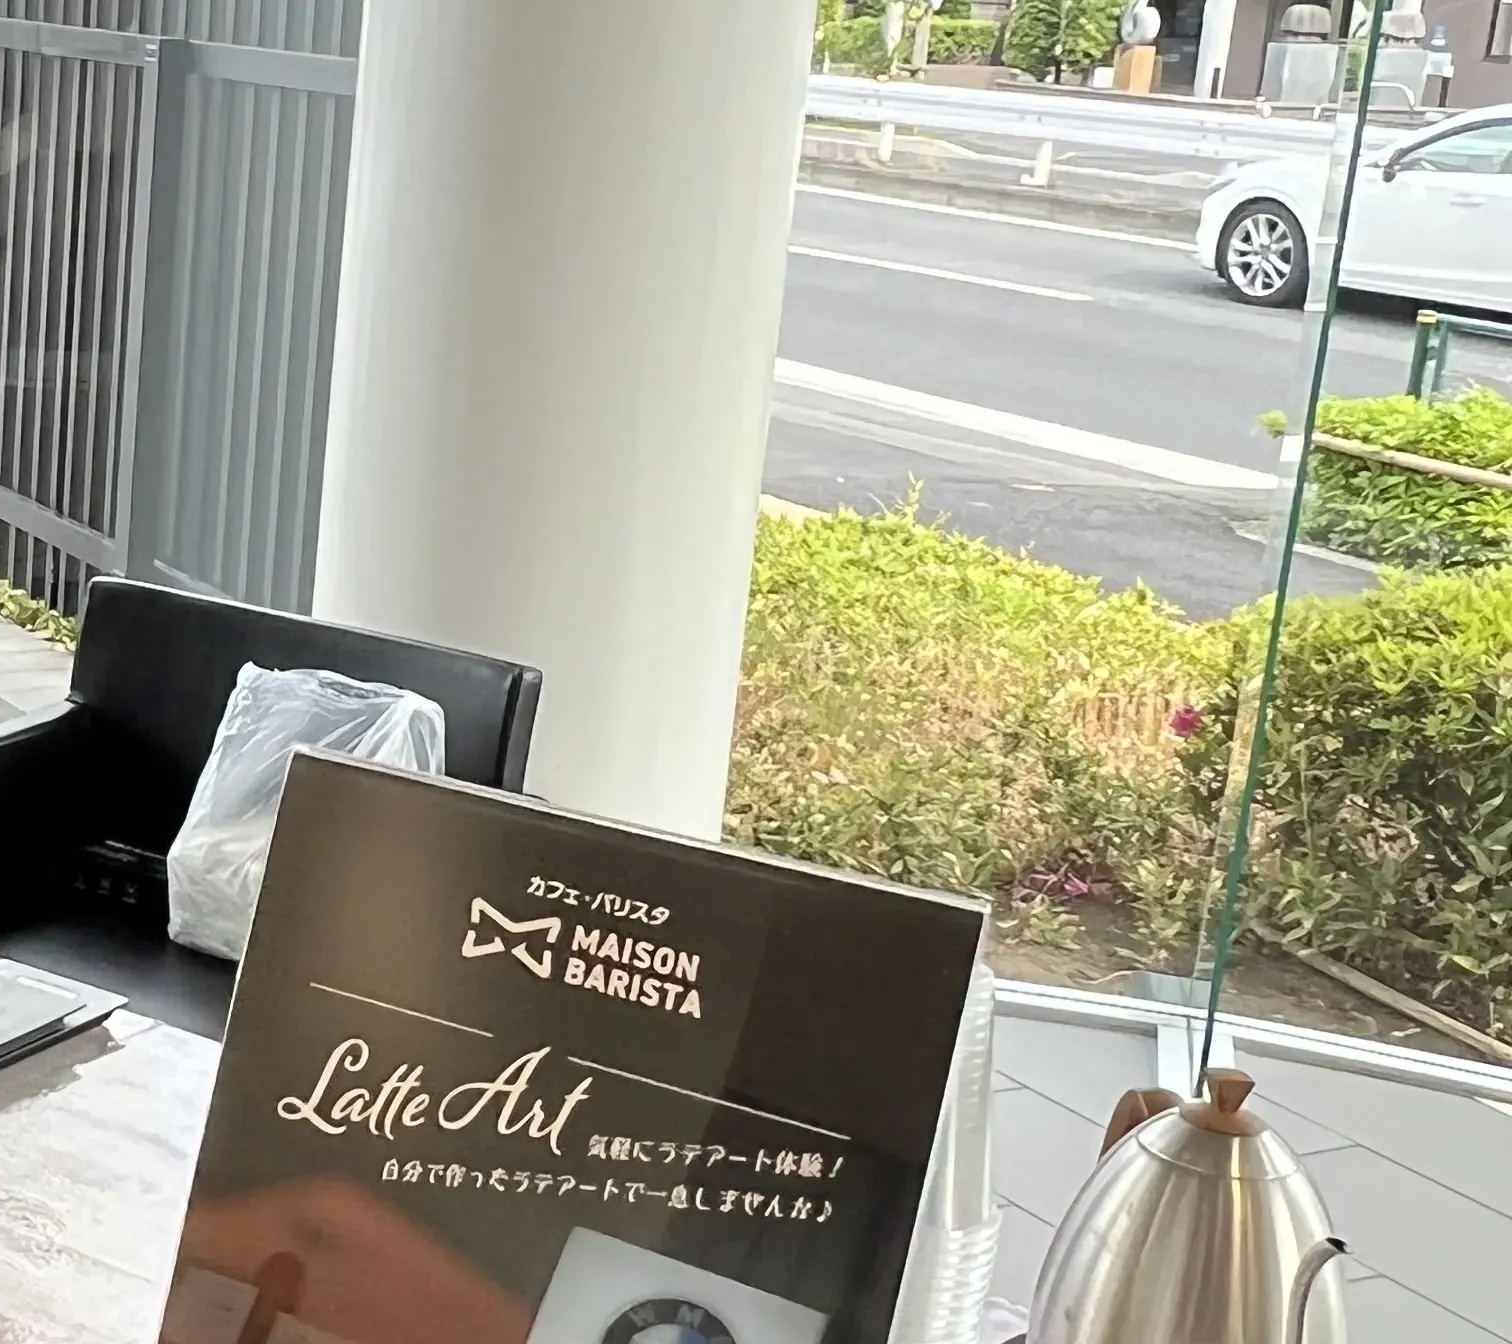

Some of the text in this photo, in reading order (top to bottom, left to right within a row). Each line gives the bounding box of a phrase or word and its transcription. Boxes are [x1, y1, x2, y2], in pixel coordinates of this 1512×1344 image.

[571, 924, 701, 983] MAISON
[563, 956, 702, 1019] BARISTA
[276, 1037, 594, 1156] Latte Art
